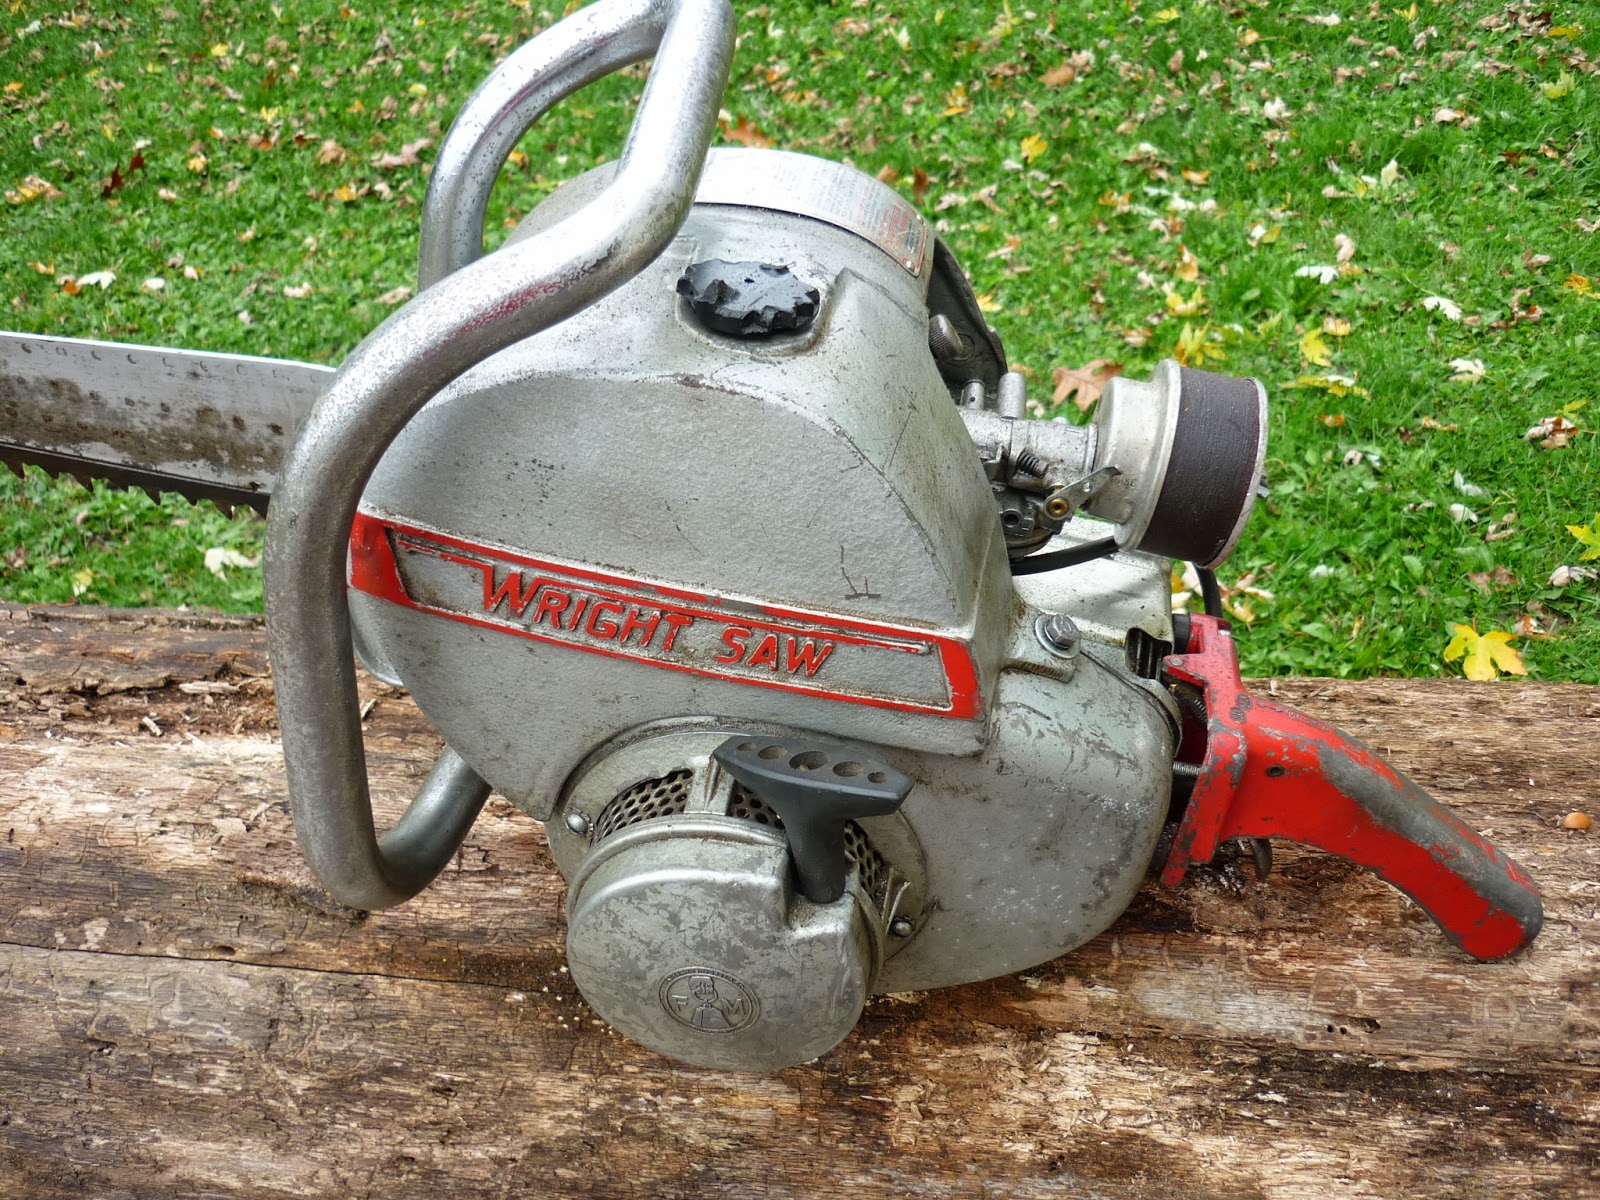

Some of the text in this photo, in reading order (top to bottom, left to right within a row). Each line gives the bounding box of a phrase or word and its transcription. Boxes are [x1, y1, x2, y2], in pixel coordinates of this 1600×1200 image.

[483, 561, 835, 678] WRIGHT SAW
[721, 998, 747, 1015] M
